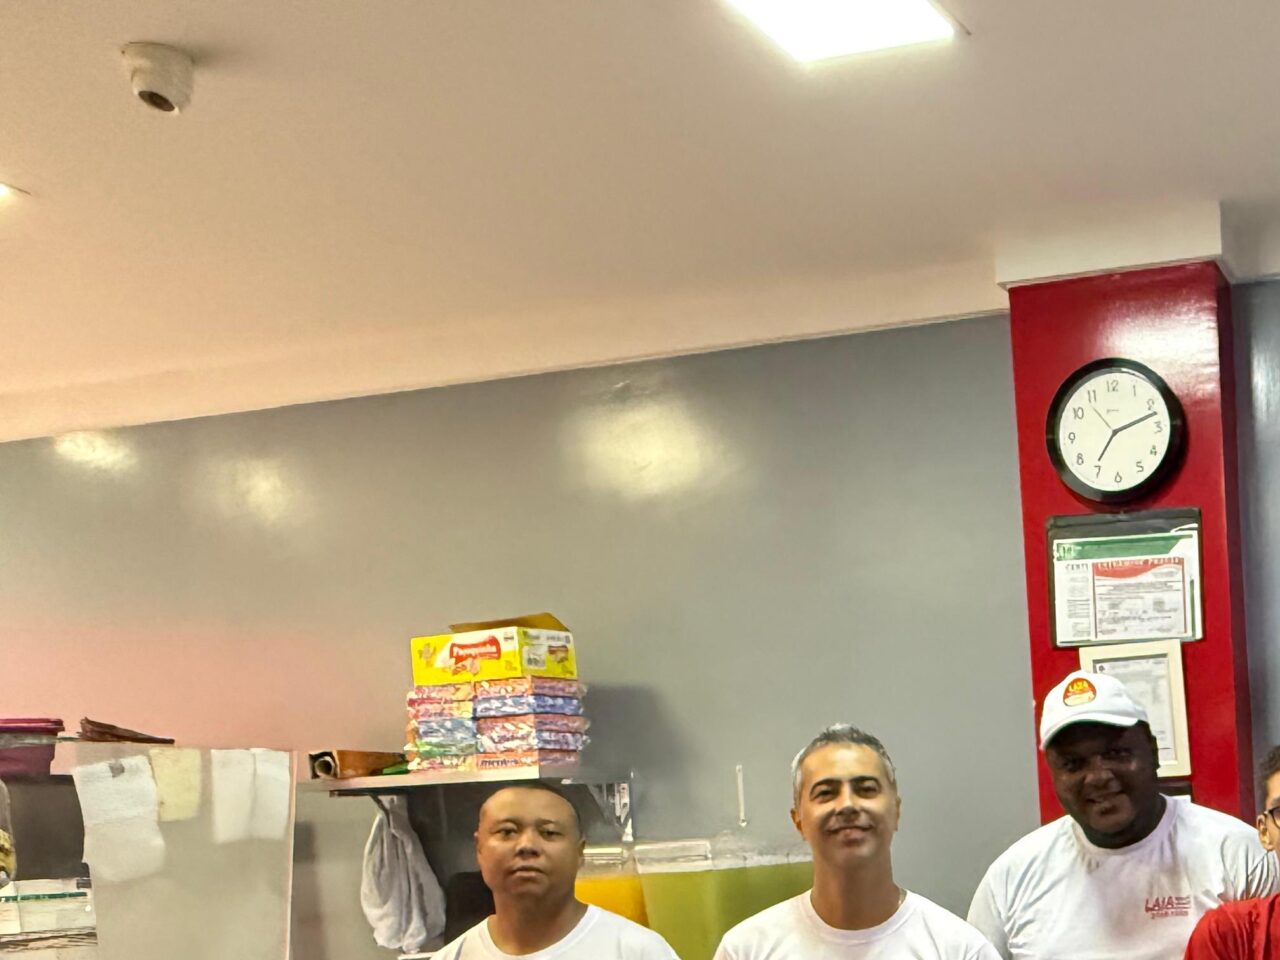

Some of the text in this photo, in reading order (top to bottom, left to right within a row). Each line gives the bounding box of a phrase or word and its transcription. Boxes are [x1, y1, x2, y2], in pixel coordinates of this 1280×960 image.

[1106, 379, 1119, 393] 12
[1087, 389, 1097, 403] 11
[1073, 406, 1085, 420] 10
[1068, 431, 1076, 444] 9
[1076, 452, 1084, 466] 8
[1094, 465, 1102, 479] 7
[1135, 460, 1144, 473] 5
[1114, 471, 1122, 484] 6
[1145, 896, 1174, 913] LAIA
